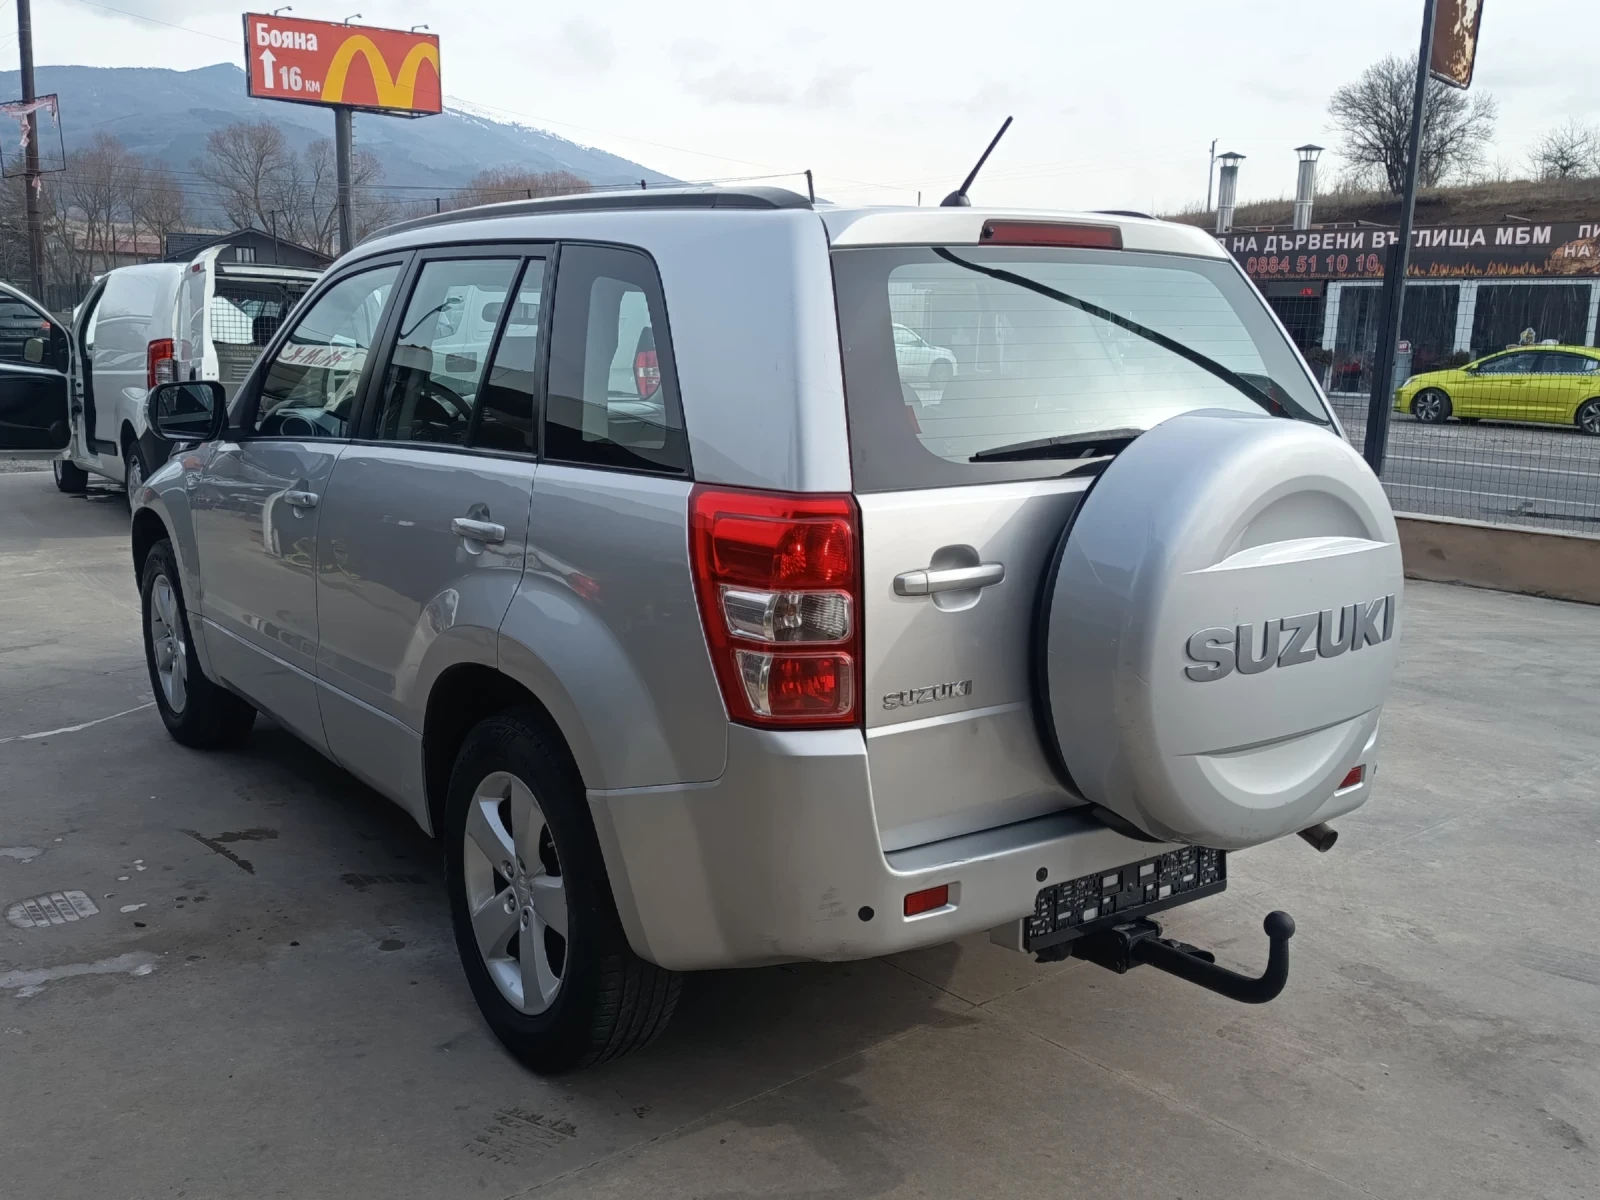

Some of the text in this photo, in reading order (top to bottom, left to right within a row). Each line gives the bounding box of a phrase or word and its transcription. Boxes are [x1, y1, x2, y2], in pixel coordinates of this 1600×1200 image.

[256, 22, 318, 51] Бояна
[279, 66, 303, 91] 16
[1233, 236, 1258, 252] НА
[1263, 231, 1364, 254] ДЪРВЕНИ
[1371, 228, 1486, 249] ВЪЛИЩА
[1495, 226, 1552, 245] МБМ
[1564, 244, 1590, 257] НА
[1247, 253, 1379, 273] 0884 51 10 10
[1185, 593, 1395, 682] SUZUKI
[883, 680, 972, 710] SUZUKI
